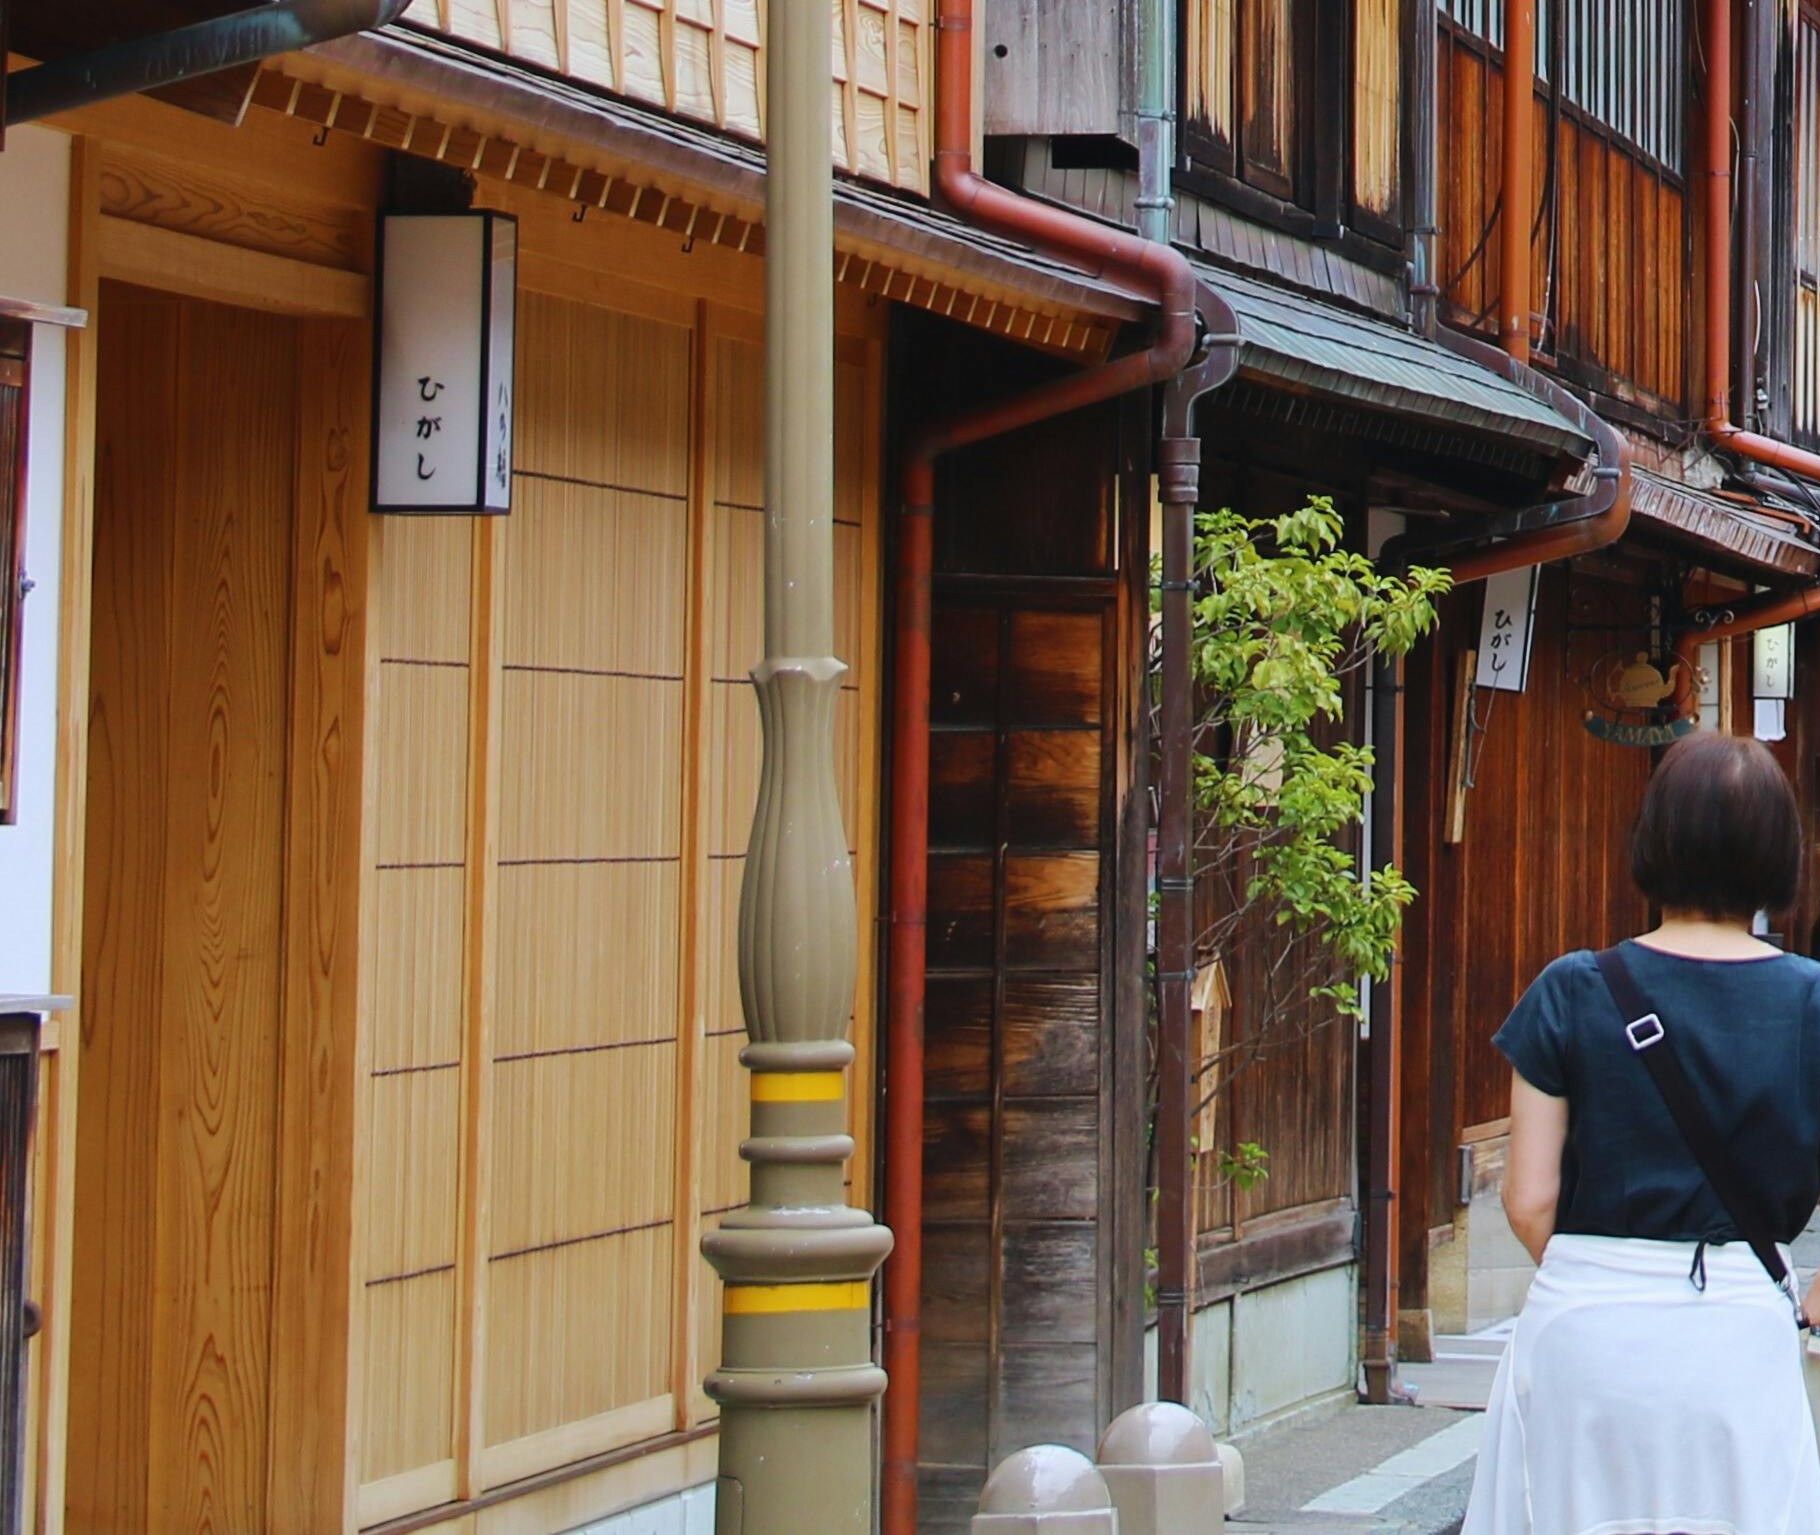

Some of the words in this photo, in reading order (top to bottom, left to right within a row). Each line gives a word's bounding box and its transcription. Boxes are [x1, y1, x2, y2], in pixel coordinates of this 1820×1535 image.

[416, 375, 445, 480] ひがし
[1490, 609, 1513, 672] ひがし
[1766, 638, 1779, 688] ひがし
